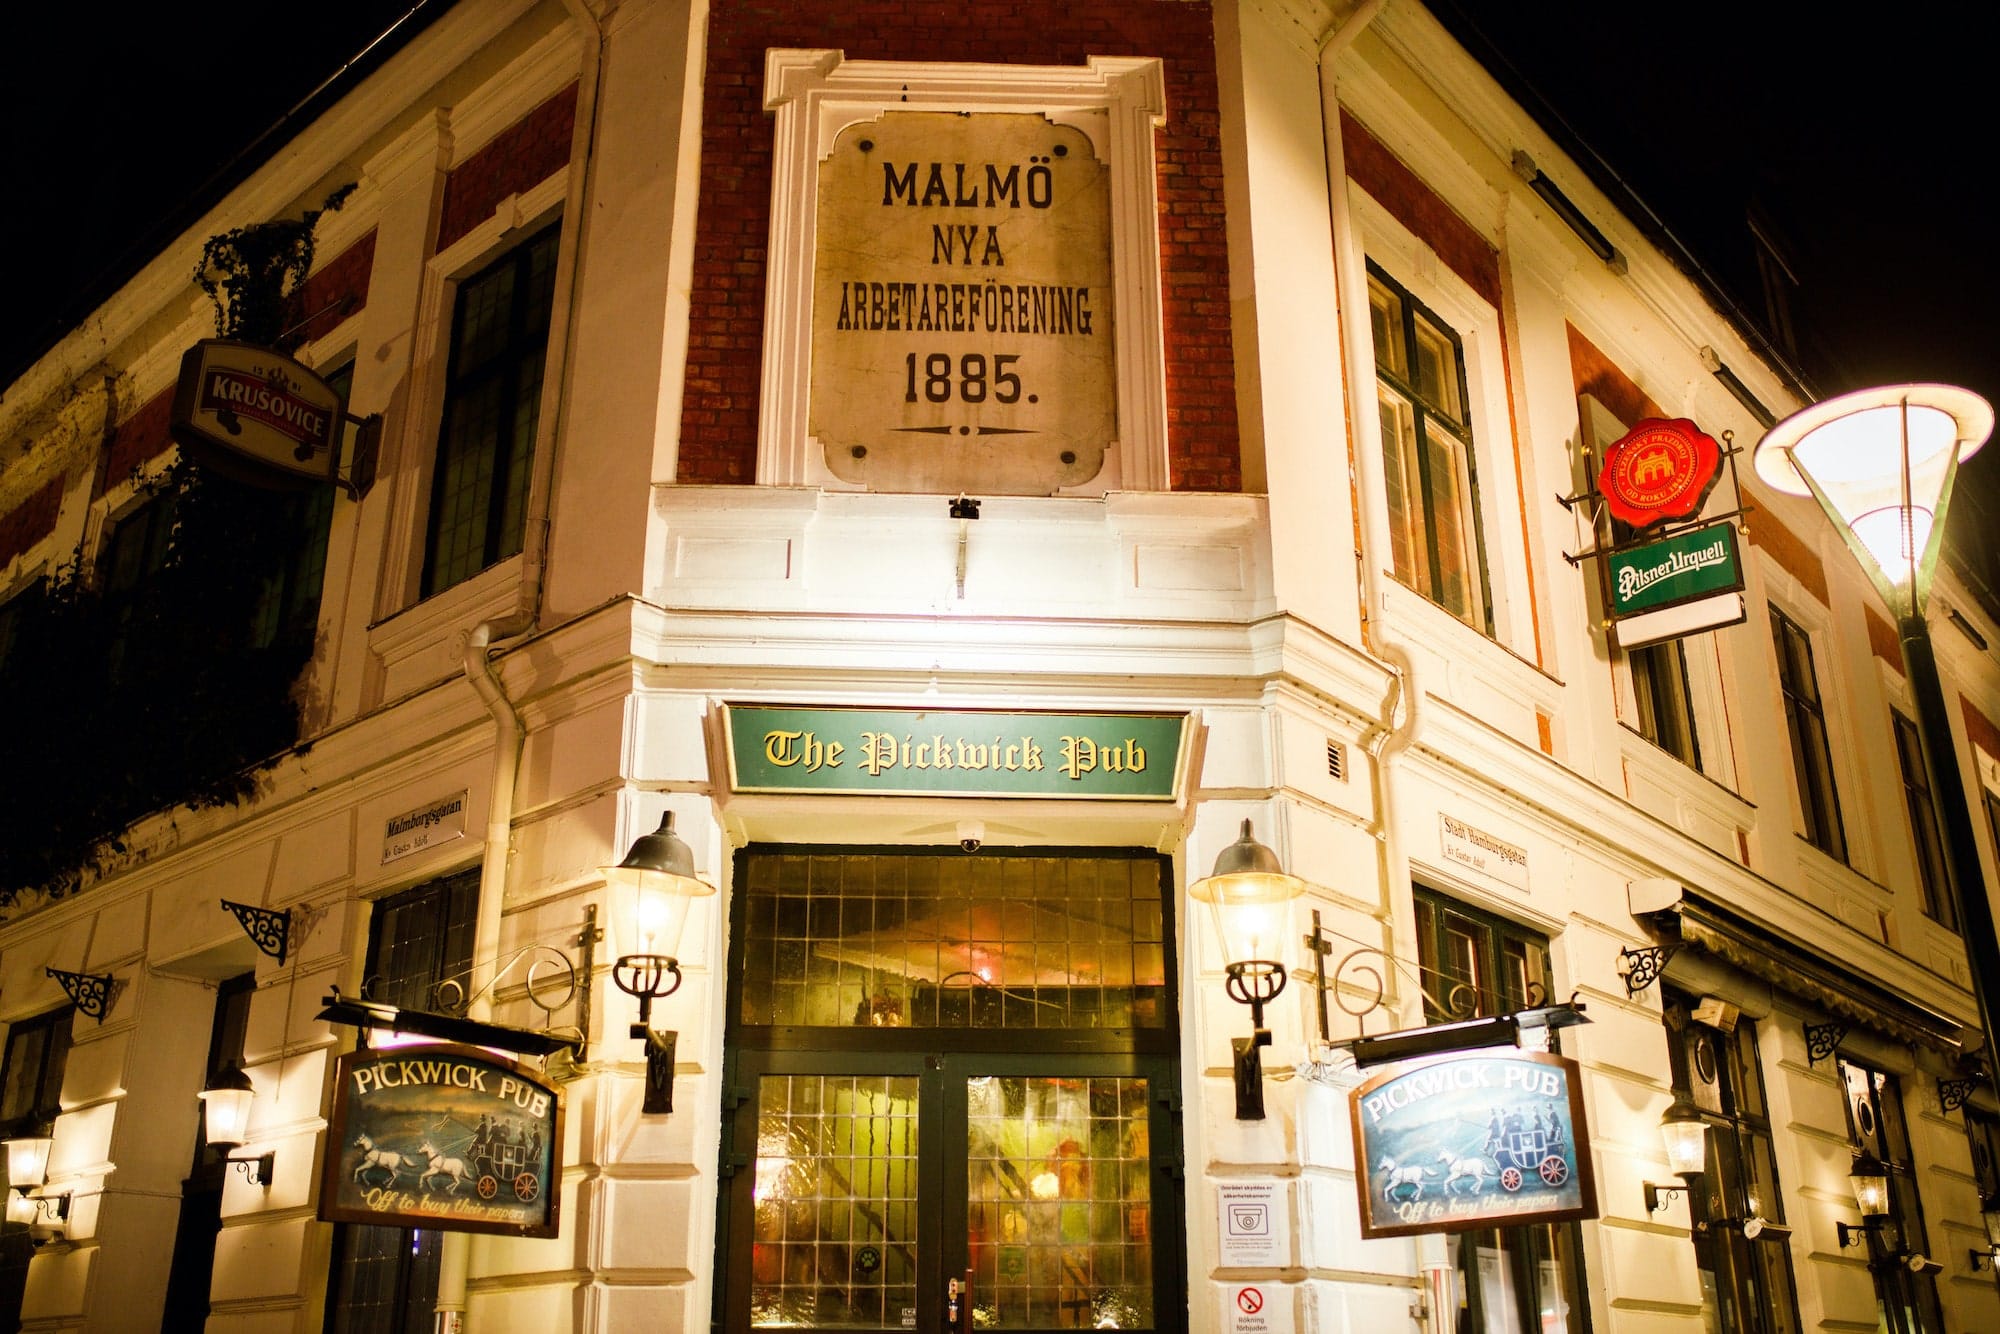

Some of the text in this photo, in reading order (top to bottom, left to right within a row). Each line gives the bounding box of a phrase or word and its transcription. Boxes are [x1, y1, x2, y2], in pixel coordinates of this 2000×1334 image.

[882, 156, 1052, 209] MALMÖ
[932, 224, 1004, 266] NYA
[837, 278, 1093, 335] ARBETAREFÖRENING
[905, 352, 1039, 404] 1885.
[212, 375, 324, 437] KRUŠOVICE
[1651, 434, 1687, 459] PRAZDROJ
[1626, 488, 1638, 499] OD
[1639, 490, 1667, 502] ROKU
[1618, 541, 1725, 602] Pilsner Urquell
[764, 730, 1147, 780] The Pickwick Pub
[353, 1060, 549, 1118] PICKWICK PUB
[1364, 1063, 1560, 1123] PICKWICK PUB
[360, 1187, 525, 1221] Off to buy their papers
[1393, 1201, 1428, 1224] Off
[1428, 1205, 1444, 1219] to
[1449, 1197, 1479, 1215] buy
[1483, 1194, 1514, 1210] their
[1238, 1316, 1264, 1325] Rökning
